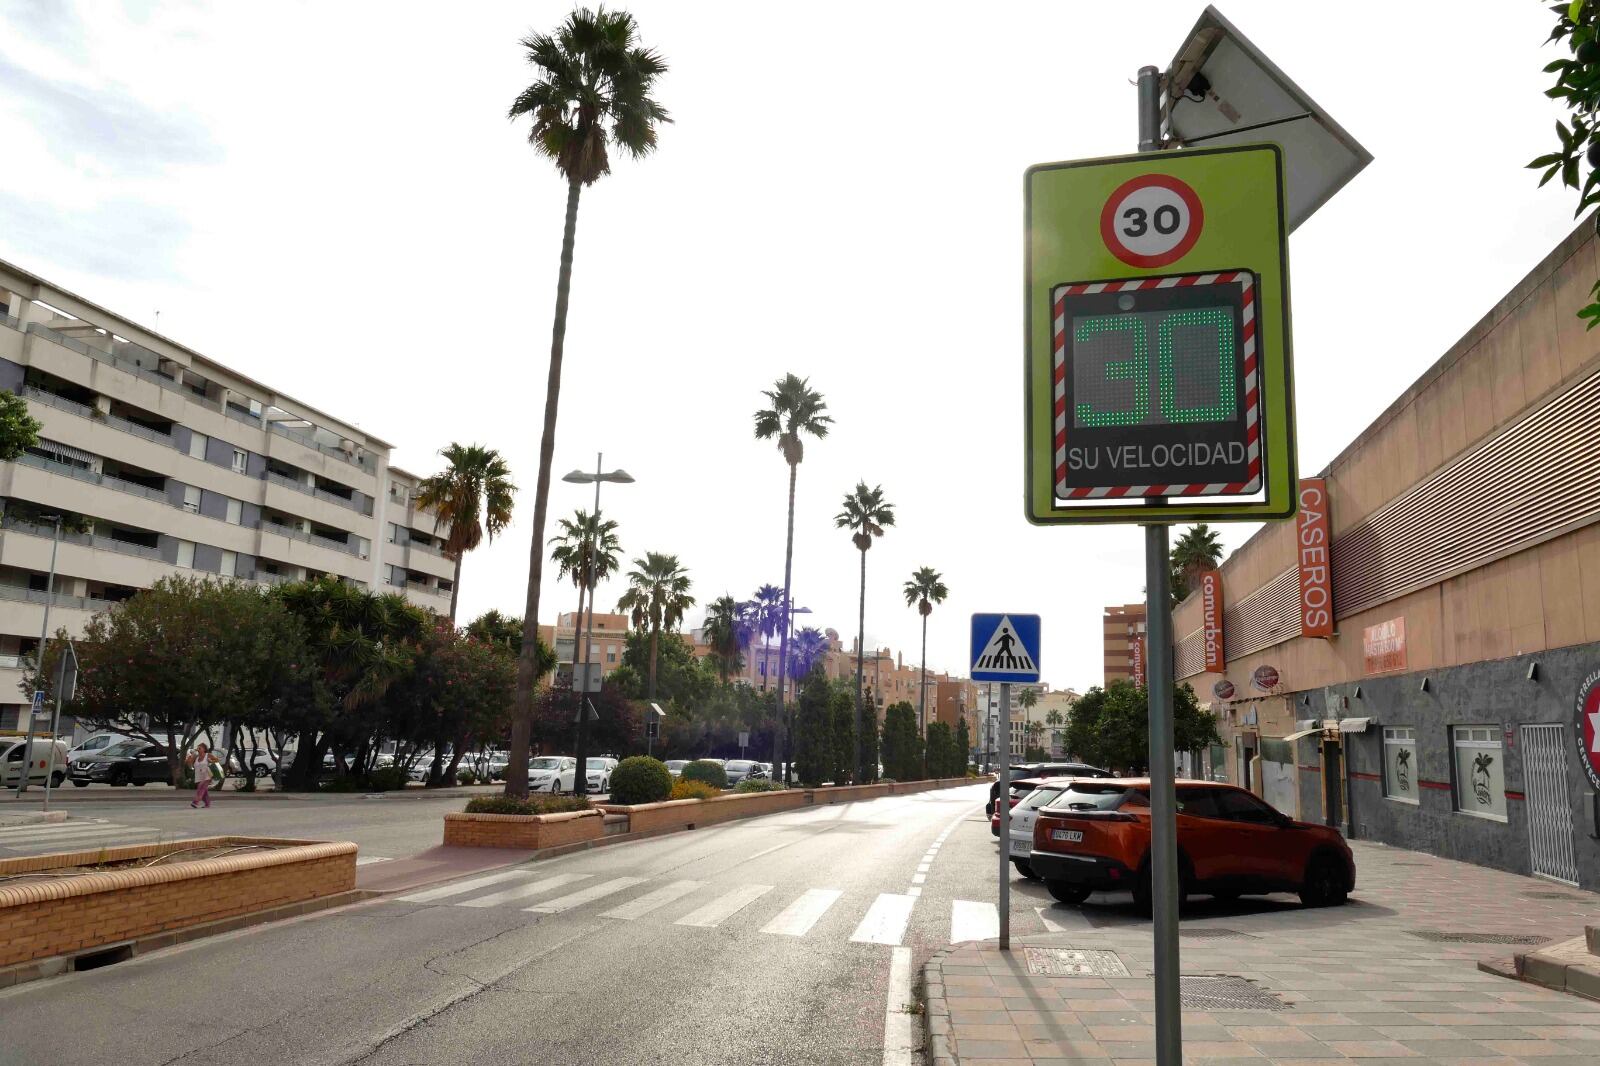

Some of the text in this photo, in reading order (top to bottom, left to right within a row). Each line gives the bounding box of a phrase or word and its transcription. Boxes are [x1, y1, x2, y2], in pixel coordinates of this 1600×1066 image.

[1123, 204, 1181, 238] 30
[1076, 310, 1235, 427] 30
[1068, 441, 1246, 470] SU VELOCIDAD
[1299, 488, 1328, 628] CASEROS
